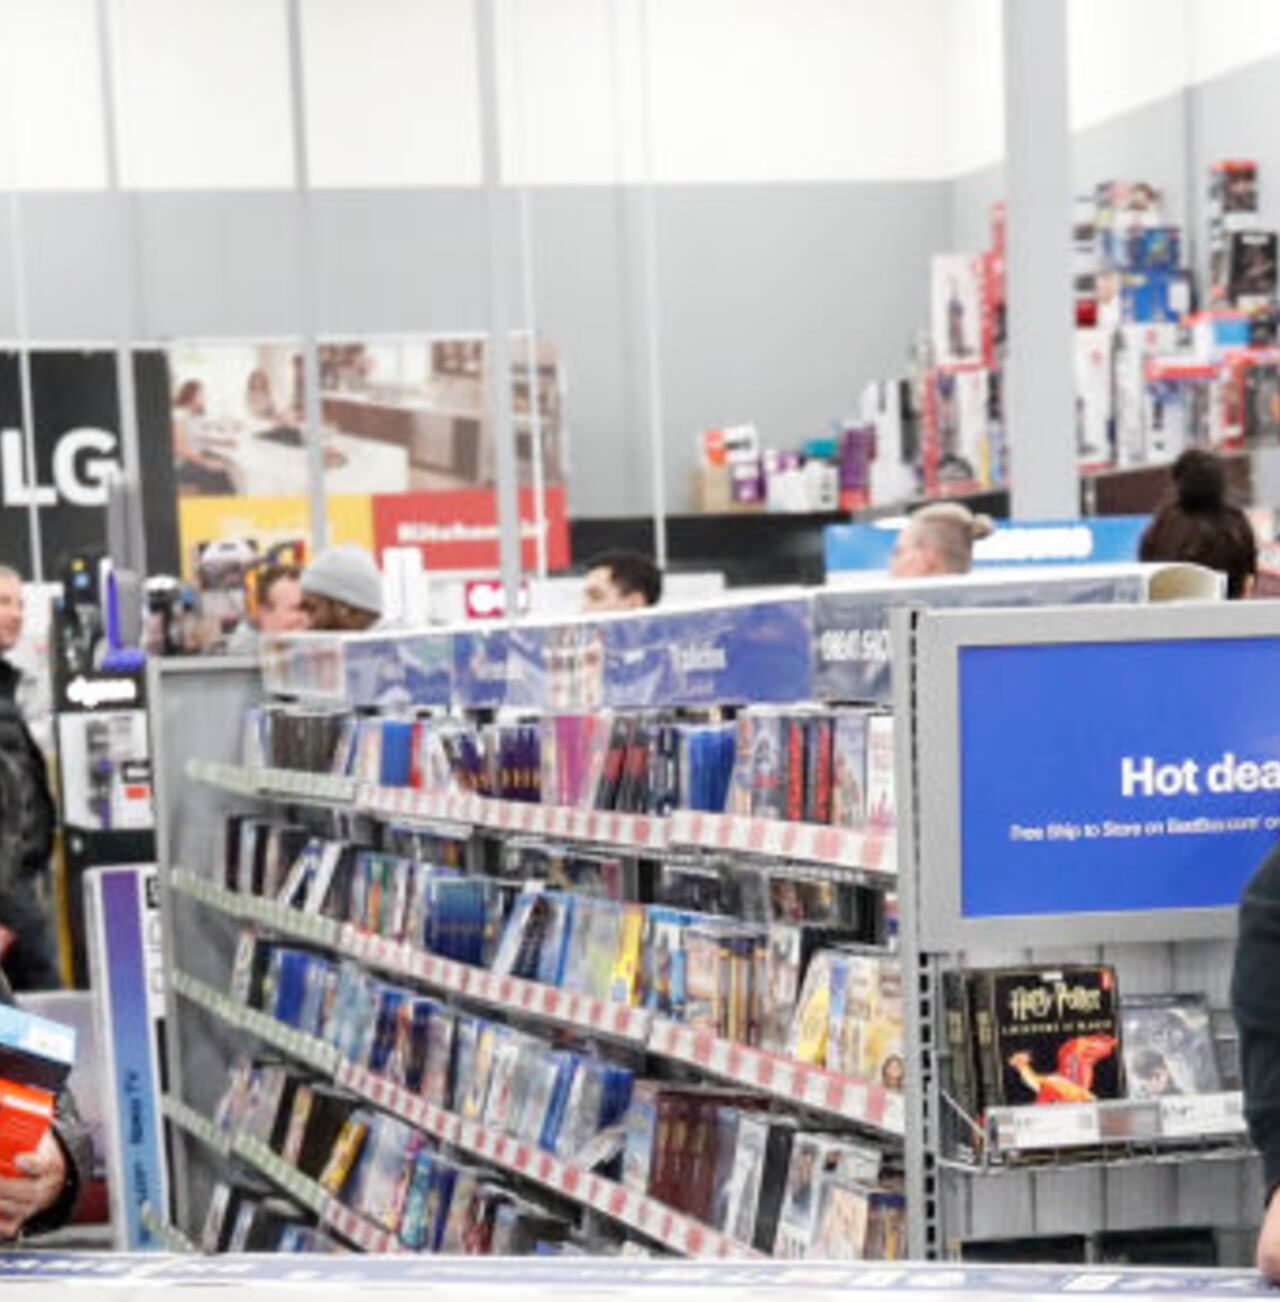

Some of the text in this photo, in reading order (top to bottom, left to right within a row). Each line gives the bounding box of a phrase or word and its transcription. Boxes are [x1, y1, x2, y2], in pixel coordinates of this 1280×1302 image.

[1, 427, 122, 506] LG
[1121, 756, 1199, 798] Hot
[1083, 822, 1100, 839] to
[1103, 819, 1143, 839] Store
